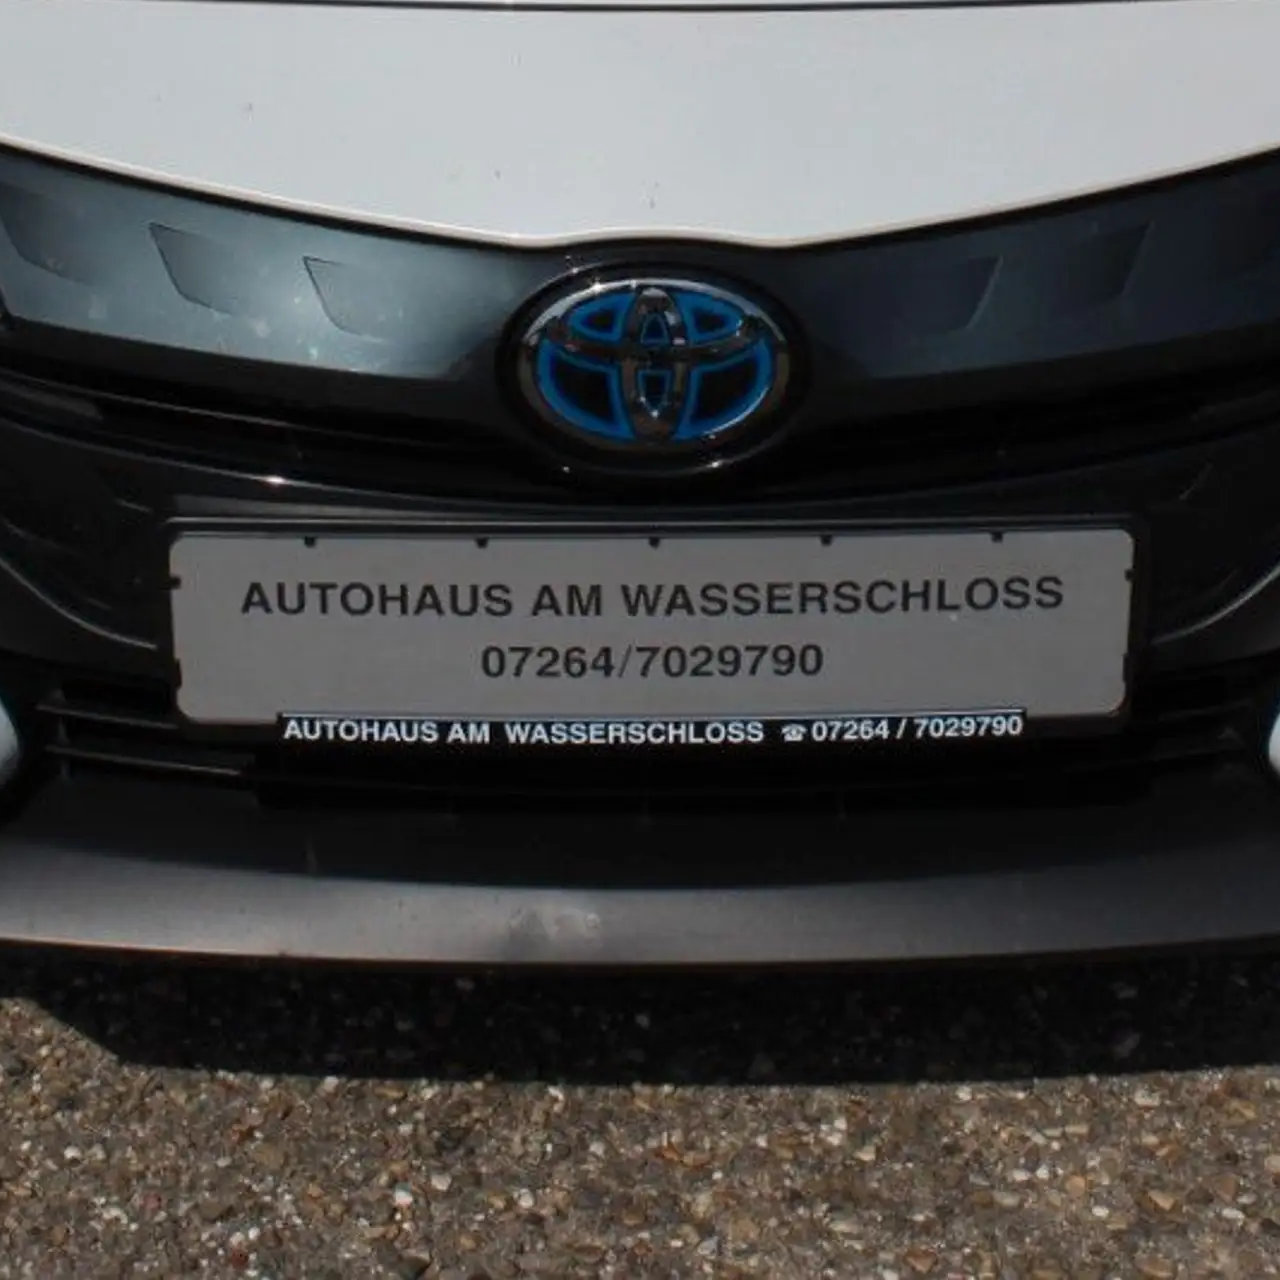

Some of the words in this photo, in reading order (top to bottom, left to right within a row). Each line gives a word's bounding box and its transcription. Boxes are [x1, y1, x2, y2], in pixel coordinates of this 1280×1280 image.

[240, 580, 514, 618] AUTOHAUS
[530, 583, 603, 618] AM
[619, 575, 1065, 618] WASSERSCHLOSS
[480, 642, 825, 680] 07264/7029790
[283, 719, 440, 743] AUTOHAUS
[446, 721, 491, 744] AM
[503, 721, 765, 745] WASSERSCHLOSS
[810, 718, 891, 742] 07264
[913, 715, 1023, 739] 7029790
